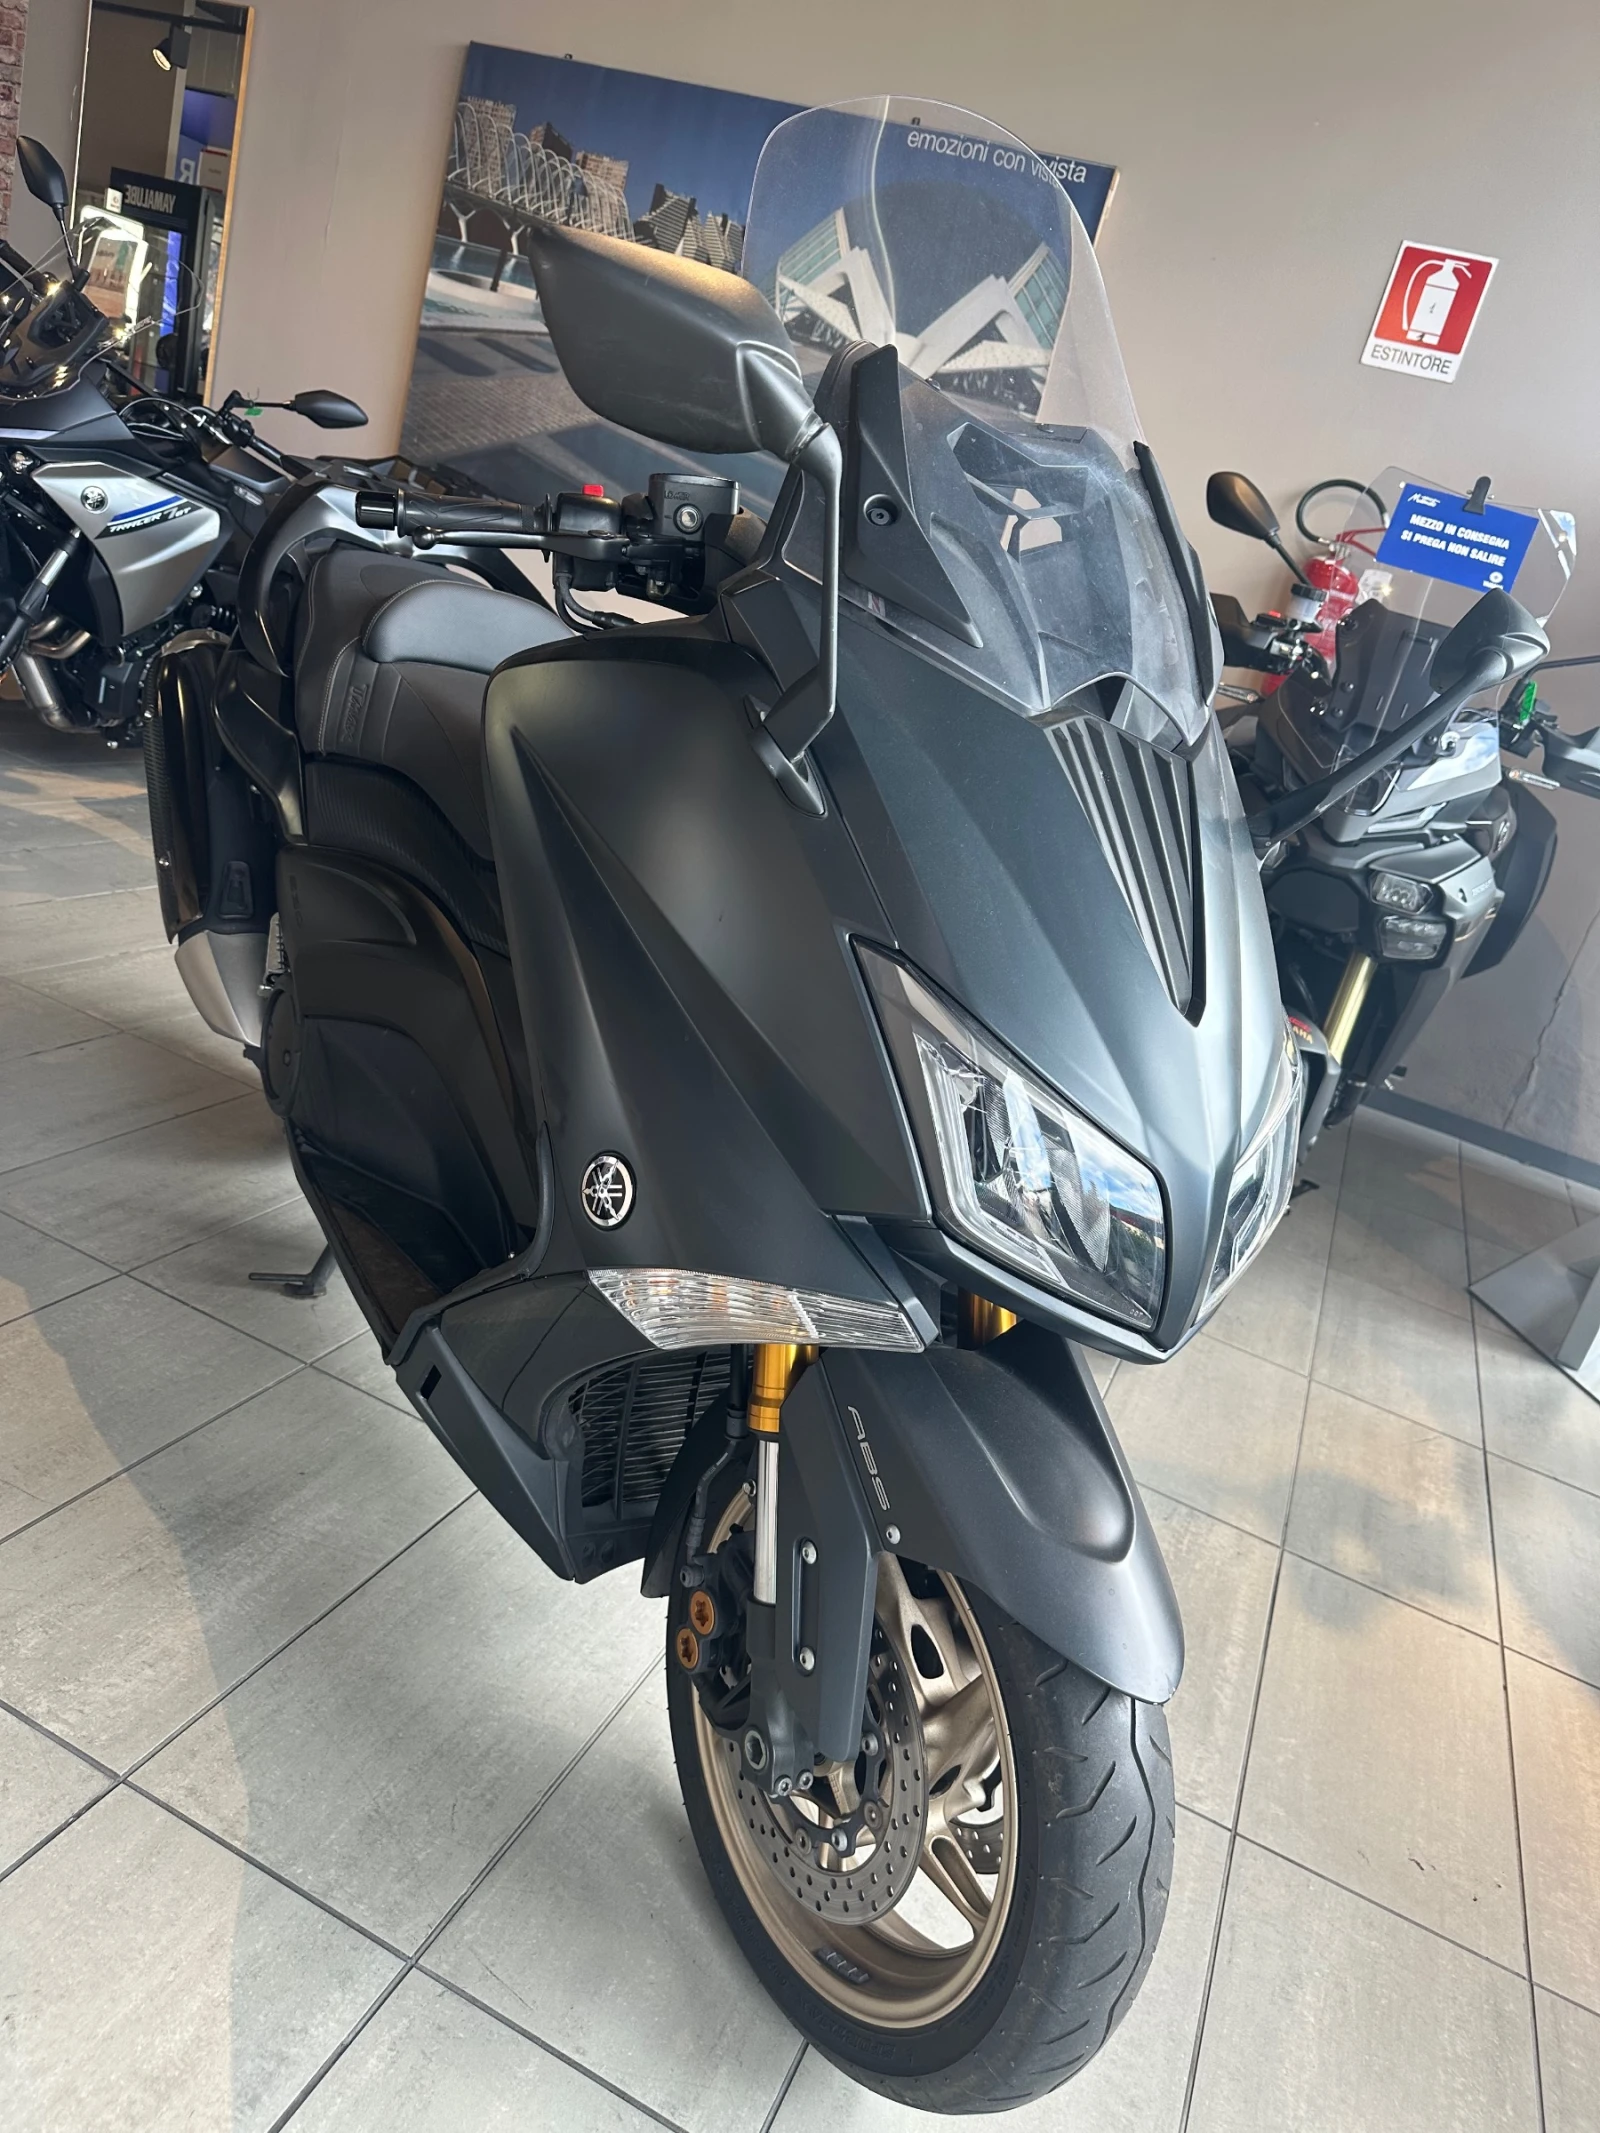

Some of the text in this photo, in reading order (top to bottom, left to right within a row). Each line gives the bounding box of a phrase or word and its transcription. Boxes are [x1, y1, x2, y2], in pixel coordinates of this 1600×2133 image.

[907, 130, 990, 163] emozioni
[993, 148, 1026, 173] con
[1370, 344, 1452, 375] ESTINTORE
[110, 512, 162, 533] TRACER
[1410, 514, 1510, 550] MEZZO IN CONSEGNA
[1401, 530, 1507, 567] SI PREGA NON SALIRE
[847, 1405, 891, 1511] ABS
